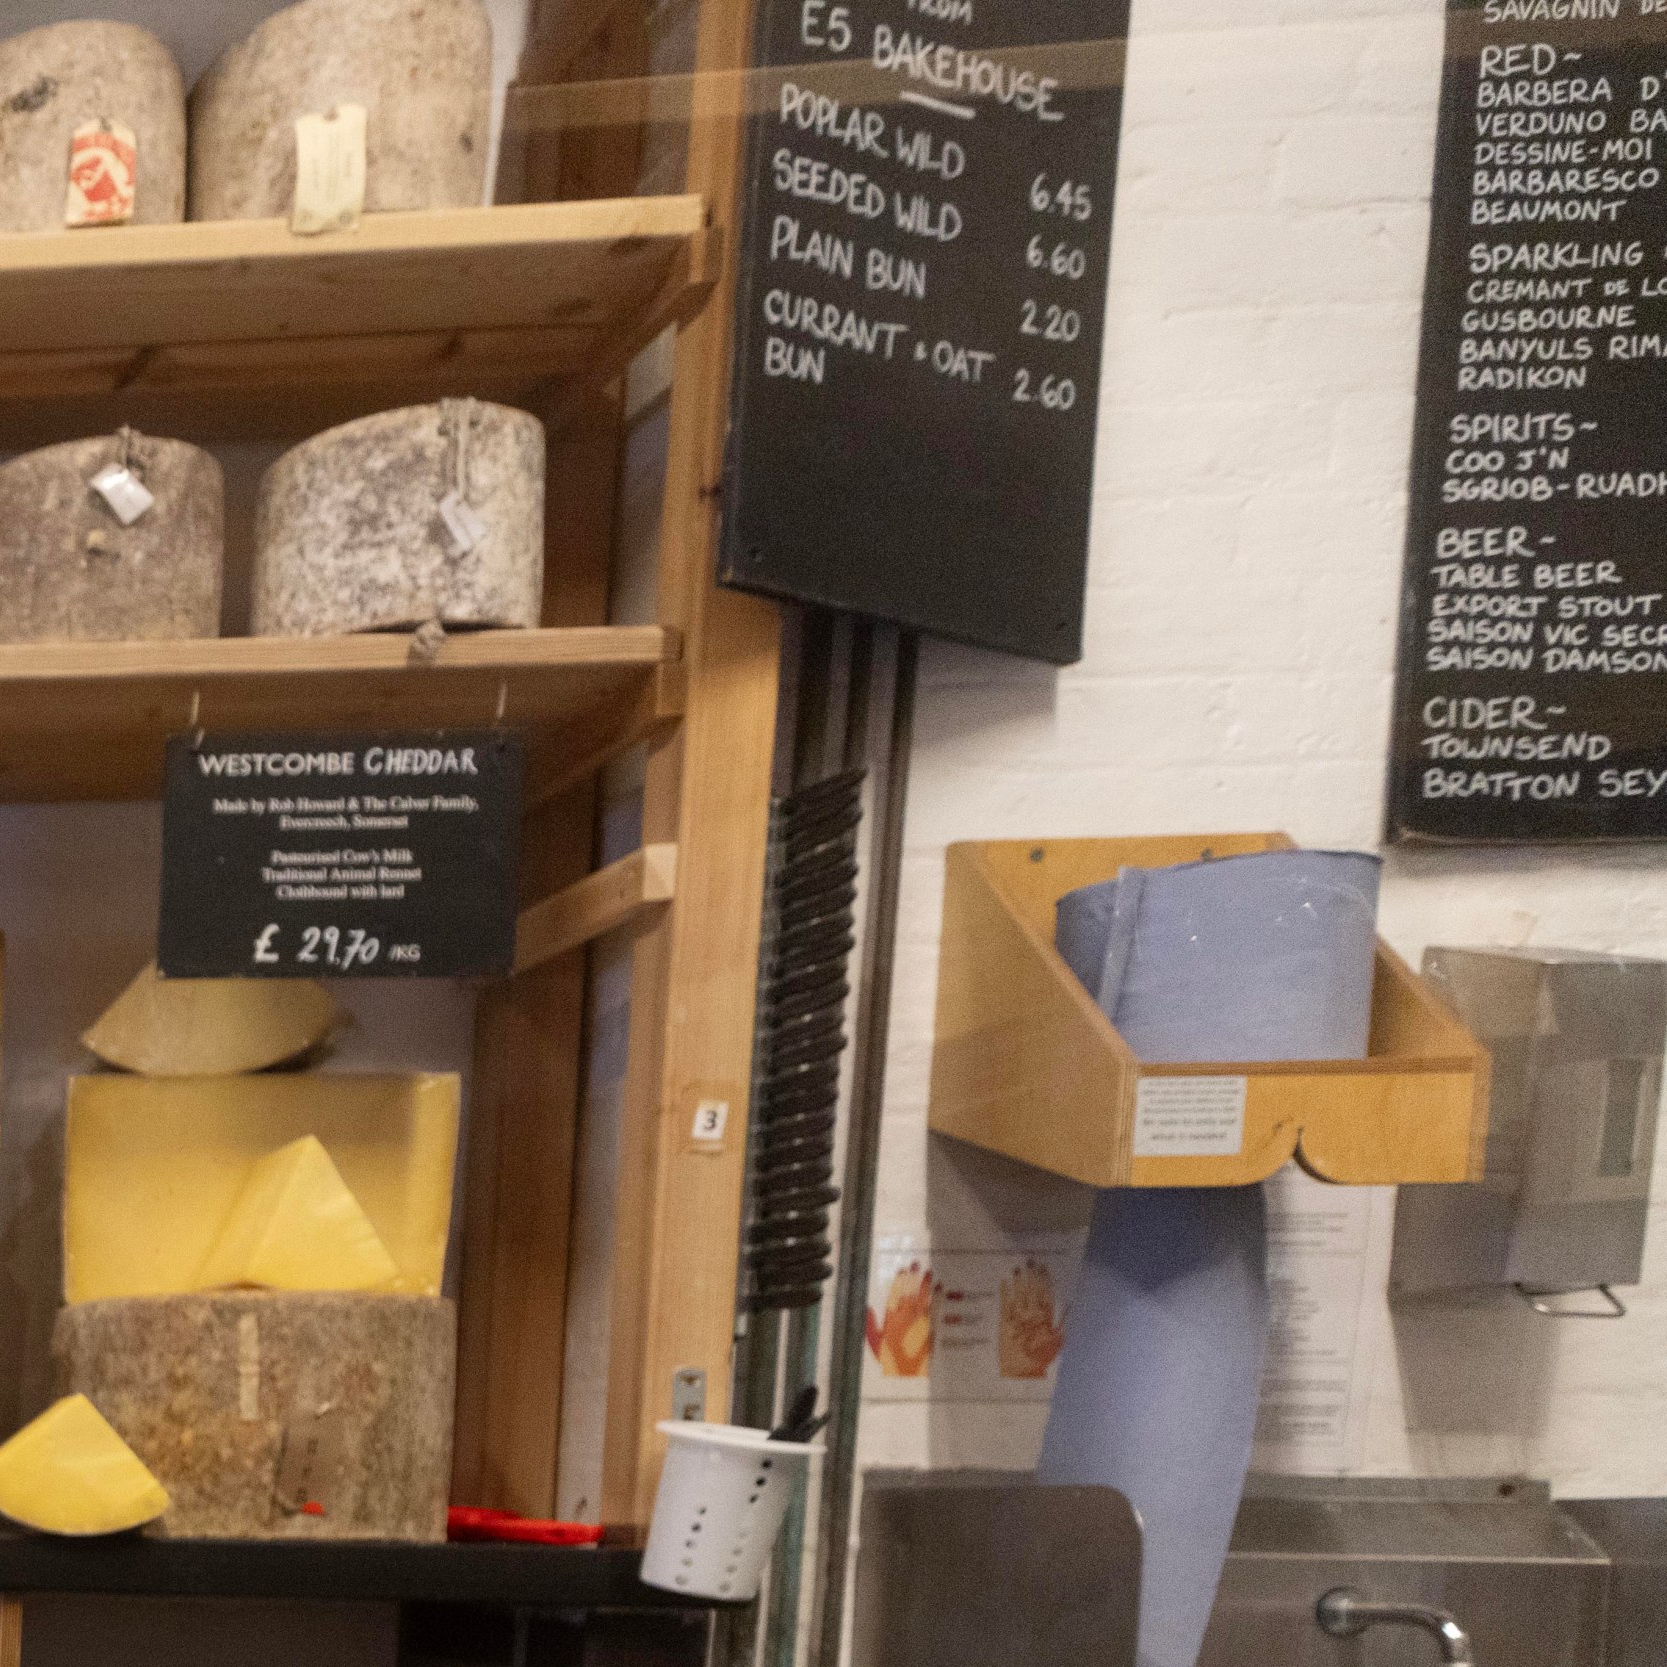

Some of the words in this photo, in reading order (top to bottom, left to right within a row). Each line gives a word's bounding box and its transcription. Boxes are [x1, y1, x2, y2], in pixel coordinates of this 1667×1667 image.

[1482, 0, 1621, 25] SAVAGNIN
[801, 0, 852, 51] E5
[872, 24, 1065, 121] BAKEHOUSE
[1475, 77, 1613, 109] BARBERA
[1474, 110, 1608, 138] VERDUNO
[779, 82, 889, 158] POPLAR
[896, 127, 966, 181] WILD
[1028, 172, 1092, 221] 6.45
[1472, 138, 1654, 166] DESSINE-MOI
[1471, 167, 1661, 197] BARBARESCO
[771, 148, 886, 219] SEEDED
[894, 192, 963, 242] WILD
[1025, 233, 1086, 281] 6.60
[1469, 198, 1628, 226] BEAUMONT
[1468, 241, 1645, 275] SPARKLING
[770, 214, 854, 280] PLAIN
[867, 248, 927, 299] BUN
[1019, 298, 1082, 344] 2.20
[1467, 277, 1593, 304] CREMANT
[1603, 278, 1631, 297] DE
[1460, 304, 1637, 334] GUSBOURNE
[763, 288, 909, 361] CURRANT
[932, 339, 997, 383] OAT
[1013, 366, 1077, 411] 2.60
[764, 335, 826, 386] BUN
[1457, 336, 1595, 365] BANYULS
[1456, 364, 1588, 392] RADIKON
[1444, 449, 1506, 475] COO
[1429, 562, 1521, 590] TABLE
[1532, 559, 1624, 590] BEER
[1430, 592, 1549, 618] EXPORT
[1557, 593, 1663, 619] STOUT
[1426, 617, 1535, 644] SAISON
[1542, 622, 1590, 647] VIC
[1425, 645, 1535, 672] SAISON
[196, 751, 355, 777] WESTCOMBE
[362, 746, 479, 776] CHEDDAR
[1420, 731, 1613, 762] TOWNSEND
[1421, 766, 1581, 802] BRATTON
[212, 797, 249, 815] Made
[250, 797, 266, 817] by
[381, 848, 414, 863] Milk
[329, 866, 377, 881] Animal
[703, 1109, 717, 1131] 3
